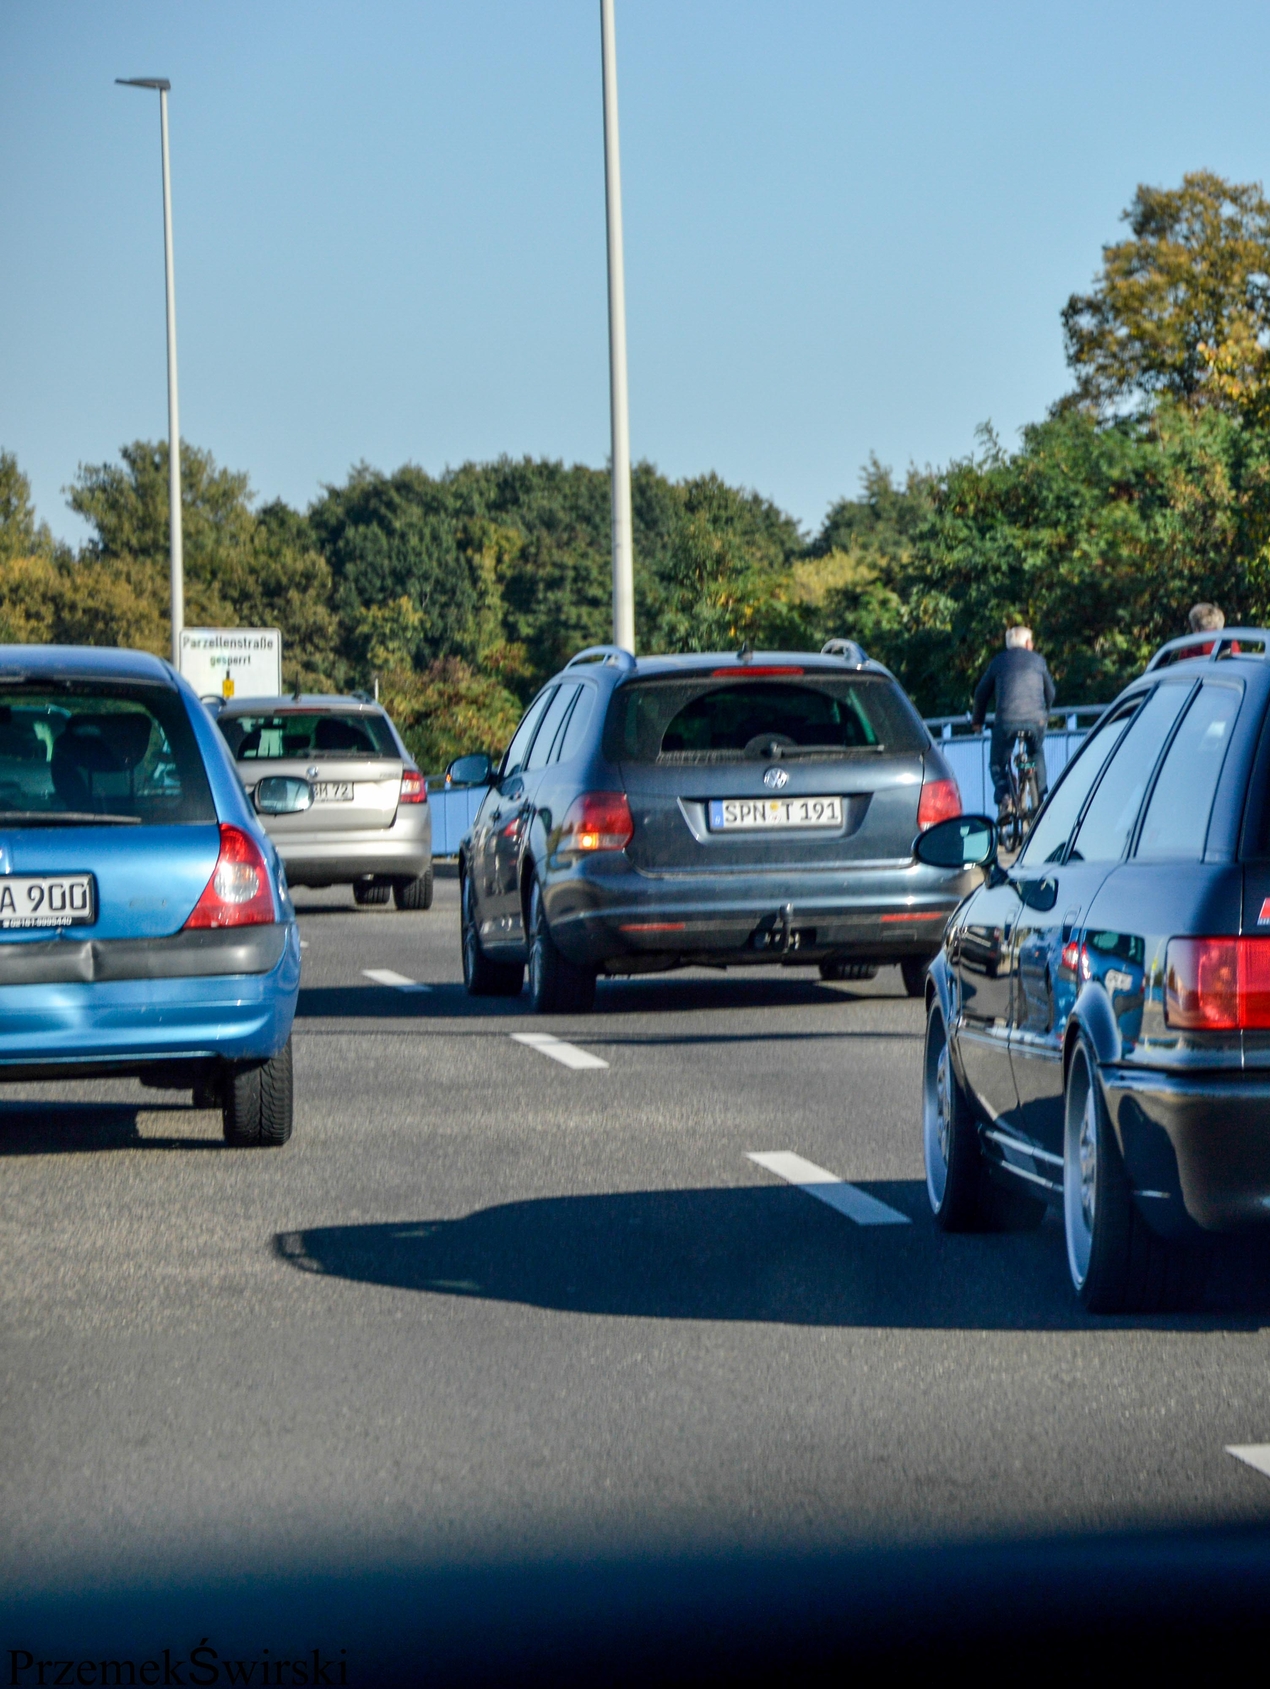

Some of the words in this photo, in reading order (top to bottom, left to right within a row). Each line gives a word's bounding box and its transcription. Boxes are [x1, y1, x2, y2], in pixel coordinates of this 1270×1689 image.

[183, 635, 273, 650] Parzellenstraße
[210, 655, 251, 668] gesperrt
[332, 782, 348, 797] 72
[724, 802, 767, 823] SPN
[780, 802, 793, 821] T
[799, 801, 838, 821] 191
[0, 885, 16, 913] A
[27, 883, 87, 912] 900
